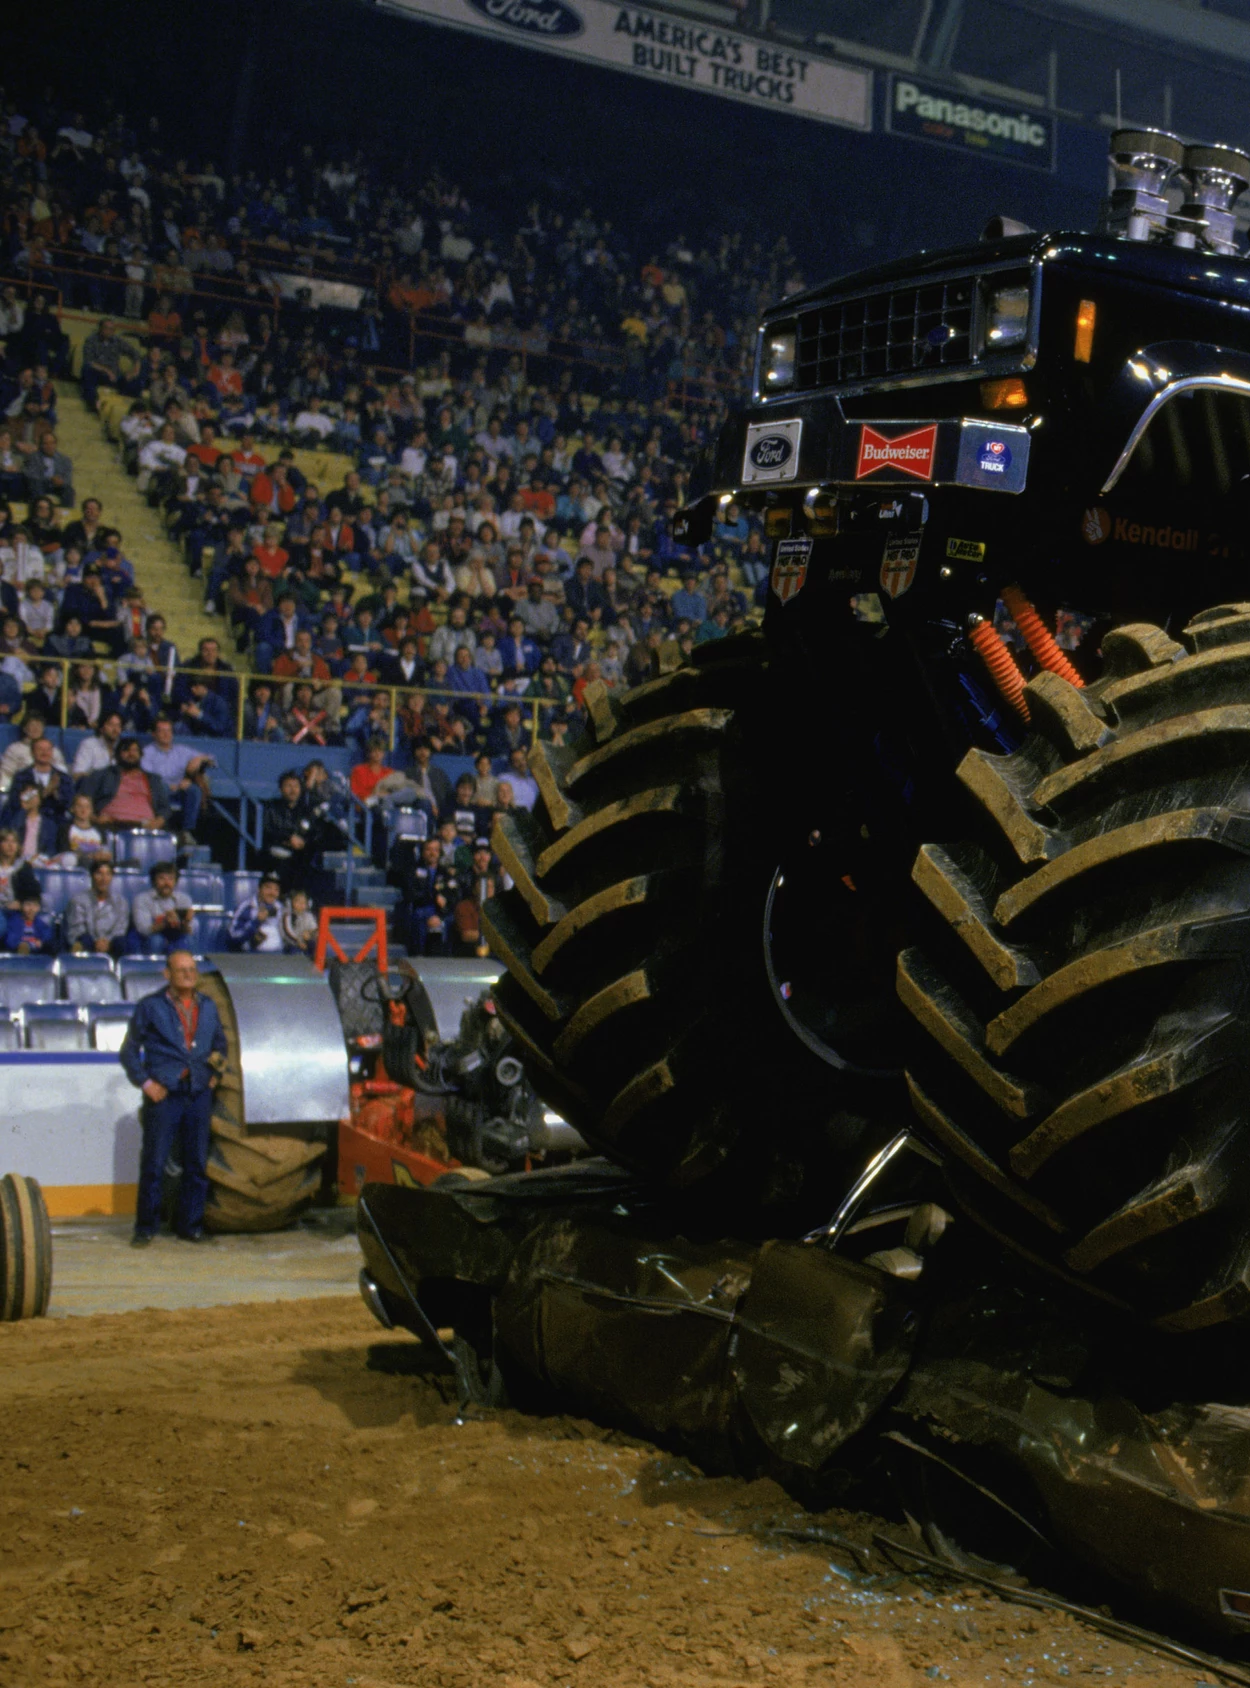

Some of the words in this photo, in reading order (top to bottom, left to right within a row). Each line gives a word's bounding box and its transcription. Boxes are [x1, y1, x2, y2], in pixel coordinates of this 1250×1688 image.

[615, 10, 742, 65] AMERICA'S
[756, 49, 808, 81] BEST
[633, 44, 698, 79] BUILT
[712, 64, 795, 103] TRUCKS
[896, 81, 1046, 147] Panasonic
[756, 439, 785, 465] Ford
[863, 444, 929, 461] Budweiser
[980, 460, 1005, 473] TRUCK
[1113, 515, 1200, 552] Kendall
